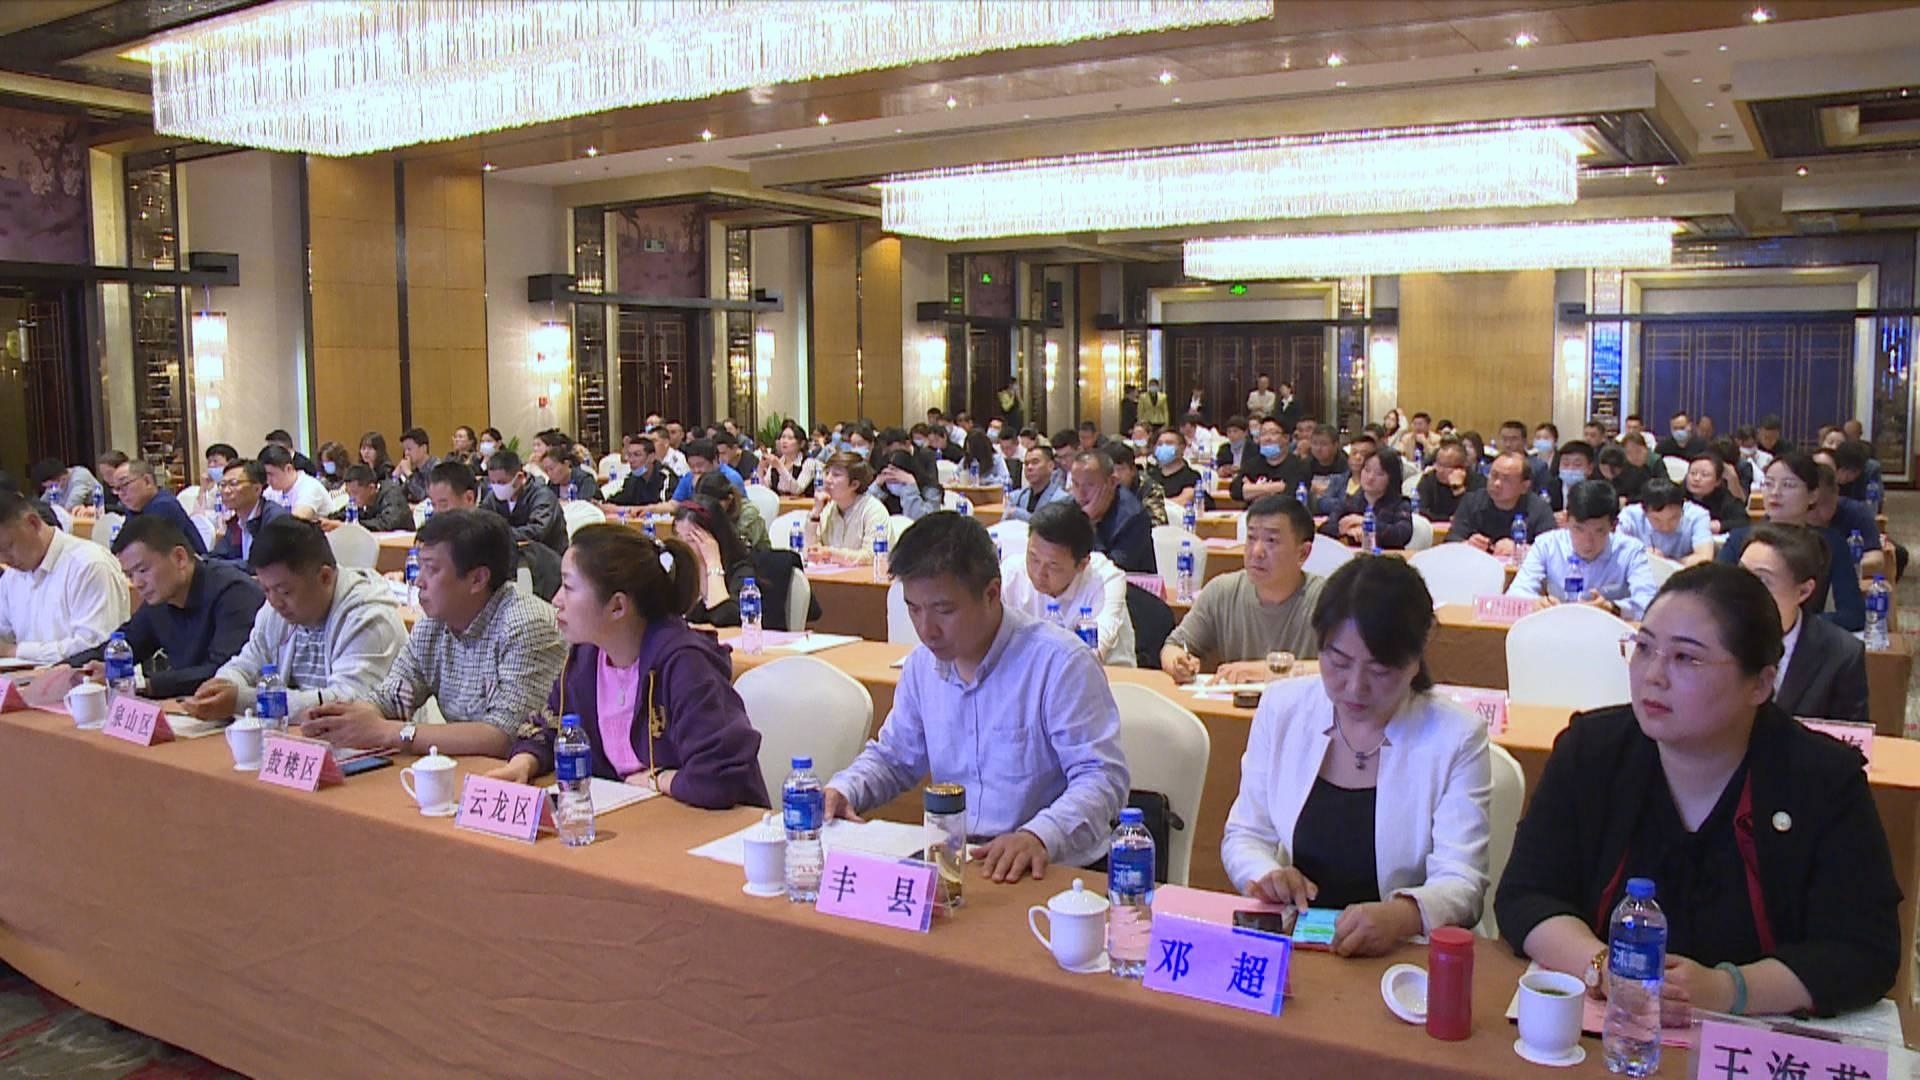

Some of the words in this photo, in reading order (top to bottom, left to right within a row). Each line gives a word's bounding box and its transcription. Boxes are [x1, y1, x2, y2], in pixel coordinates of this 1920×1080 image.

[111, 703, 153, 737] 泉山区
[265, 747, 318, 781] 鼓楼区
[469, 787, 531, 826] 云龙区
[828, 865, 917, 917] 丰县
[1154, 939, 1269, 999] 邓超
